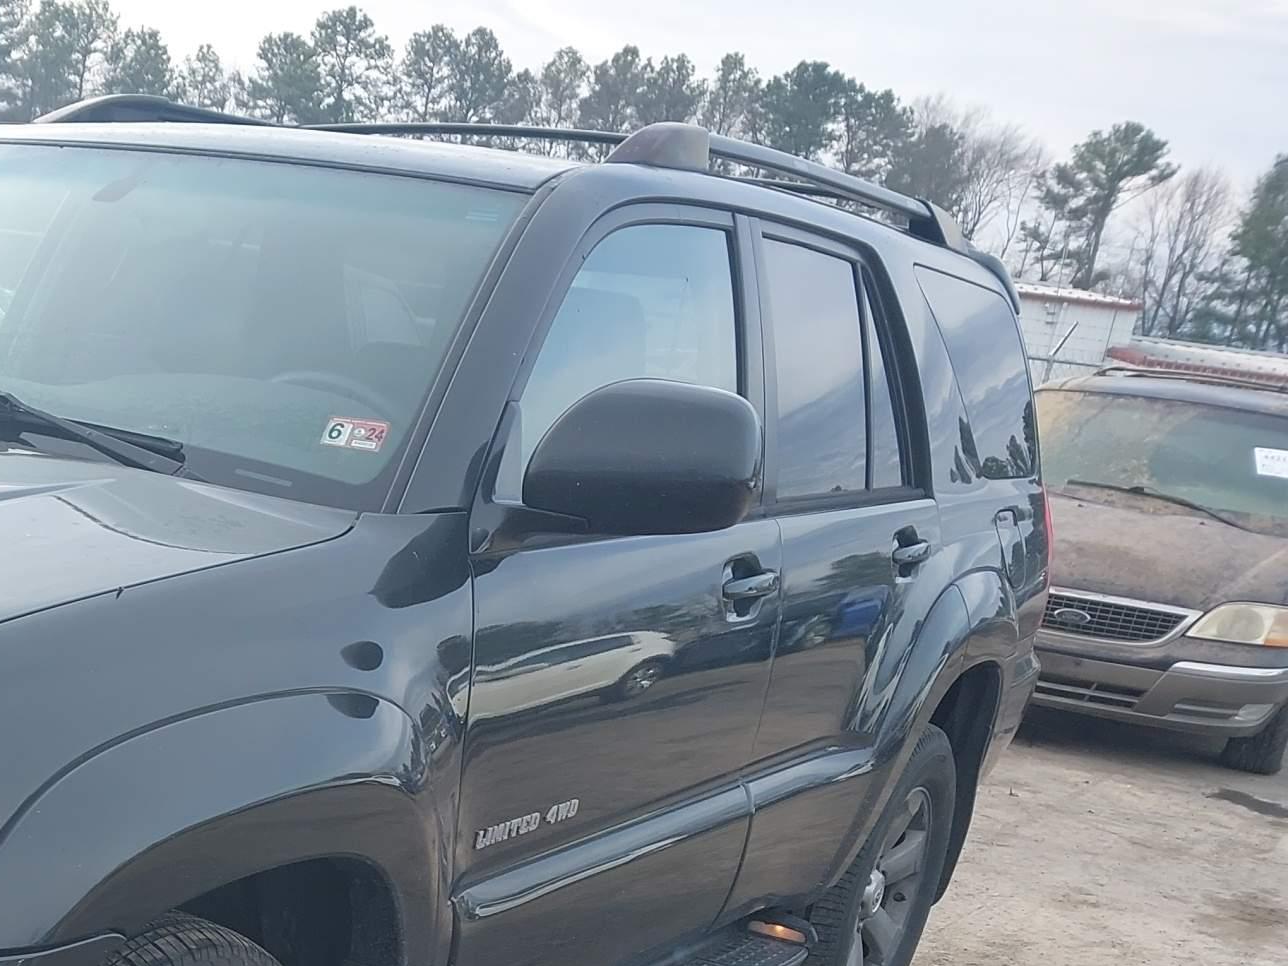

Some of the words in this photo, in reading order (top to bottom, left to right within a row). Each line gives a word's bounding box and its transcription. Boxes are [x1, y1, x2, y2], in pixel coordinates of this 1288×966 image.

[328, 422, 345, 440] 6
[365, 427, 385, 442] 24
[474, 811, 541, 850] LIMITED
[544, 798, 580, 825] 4WD
